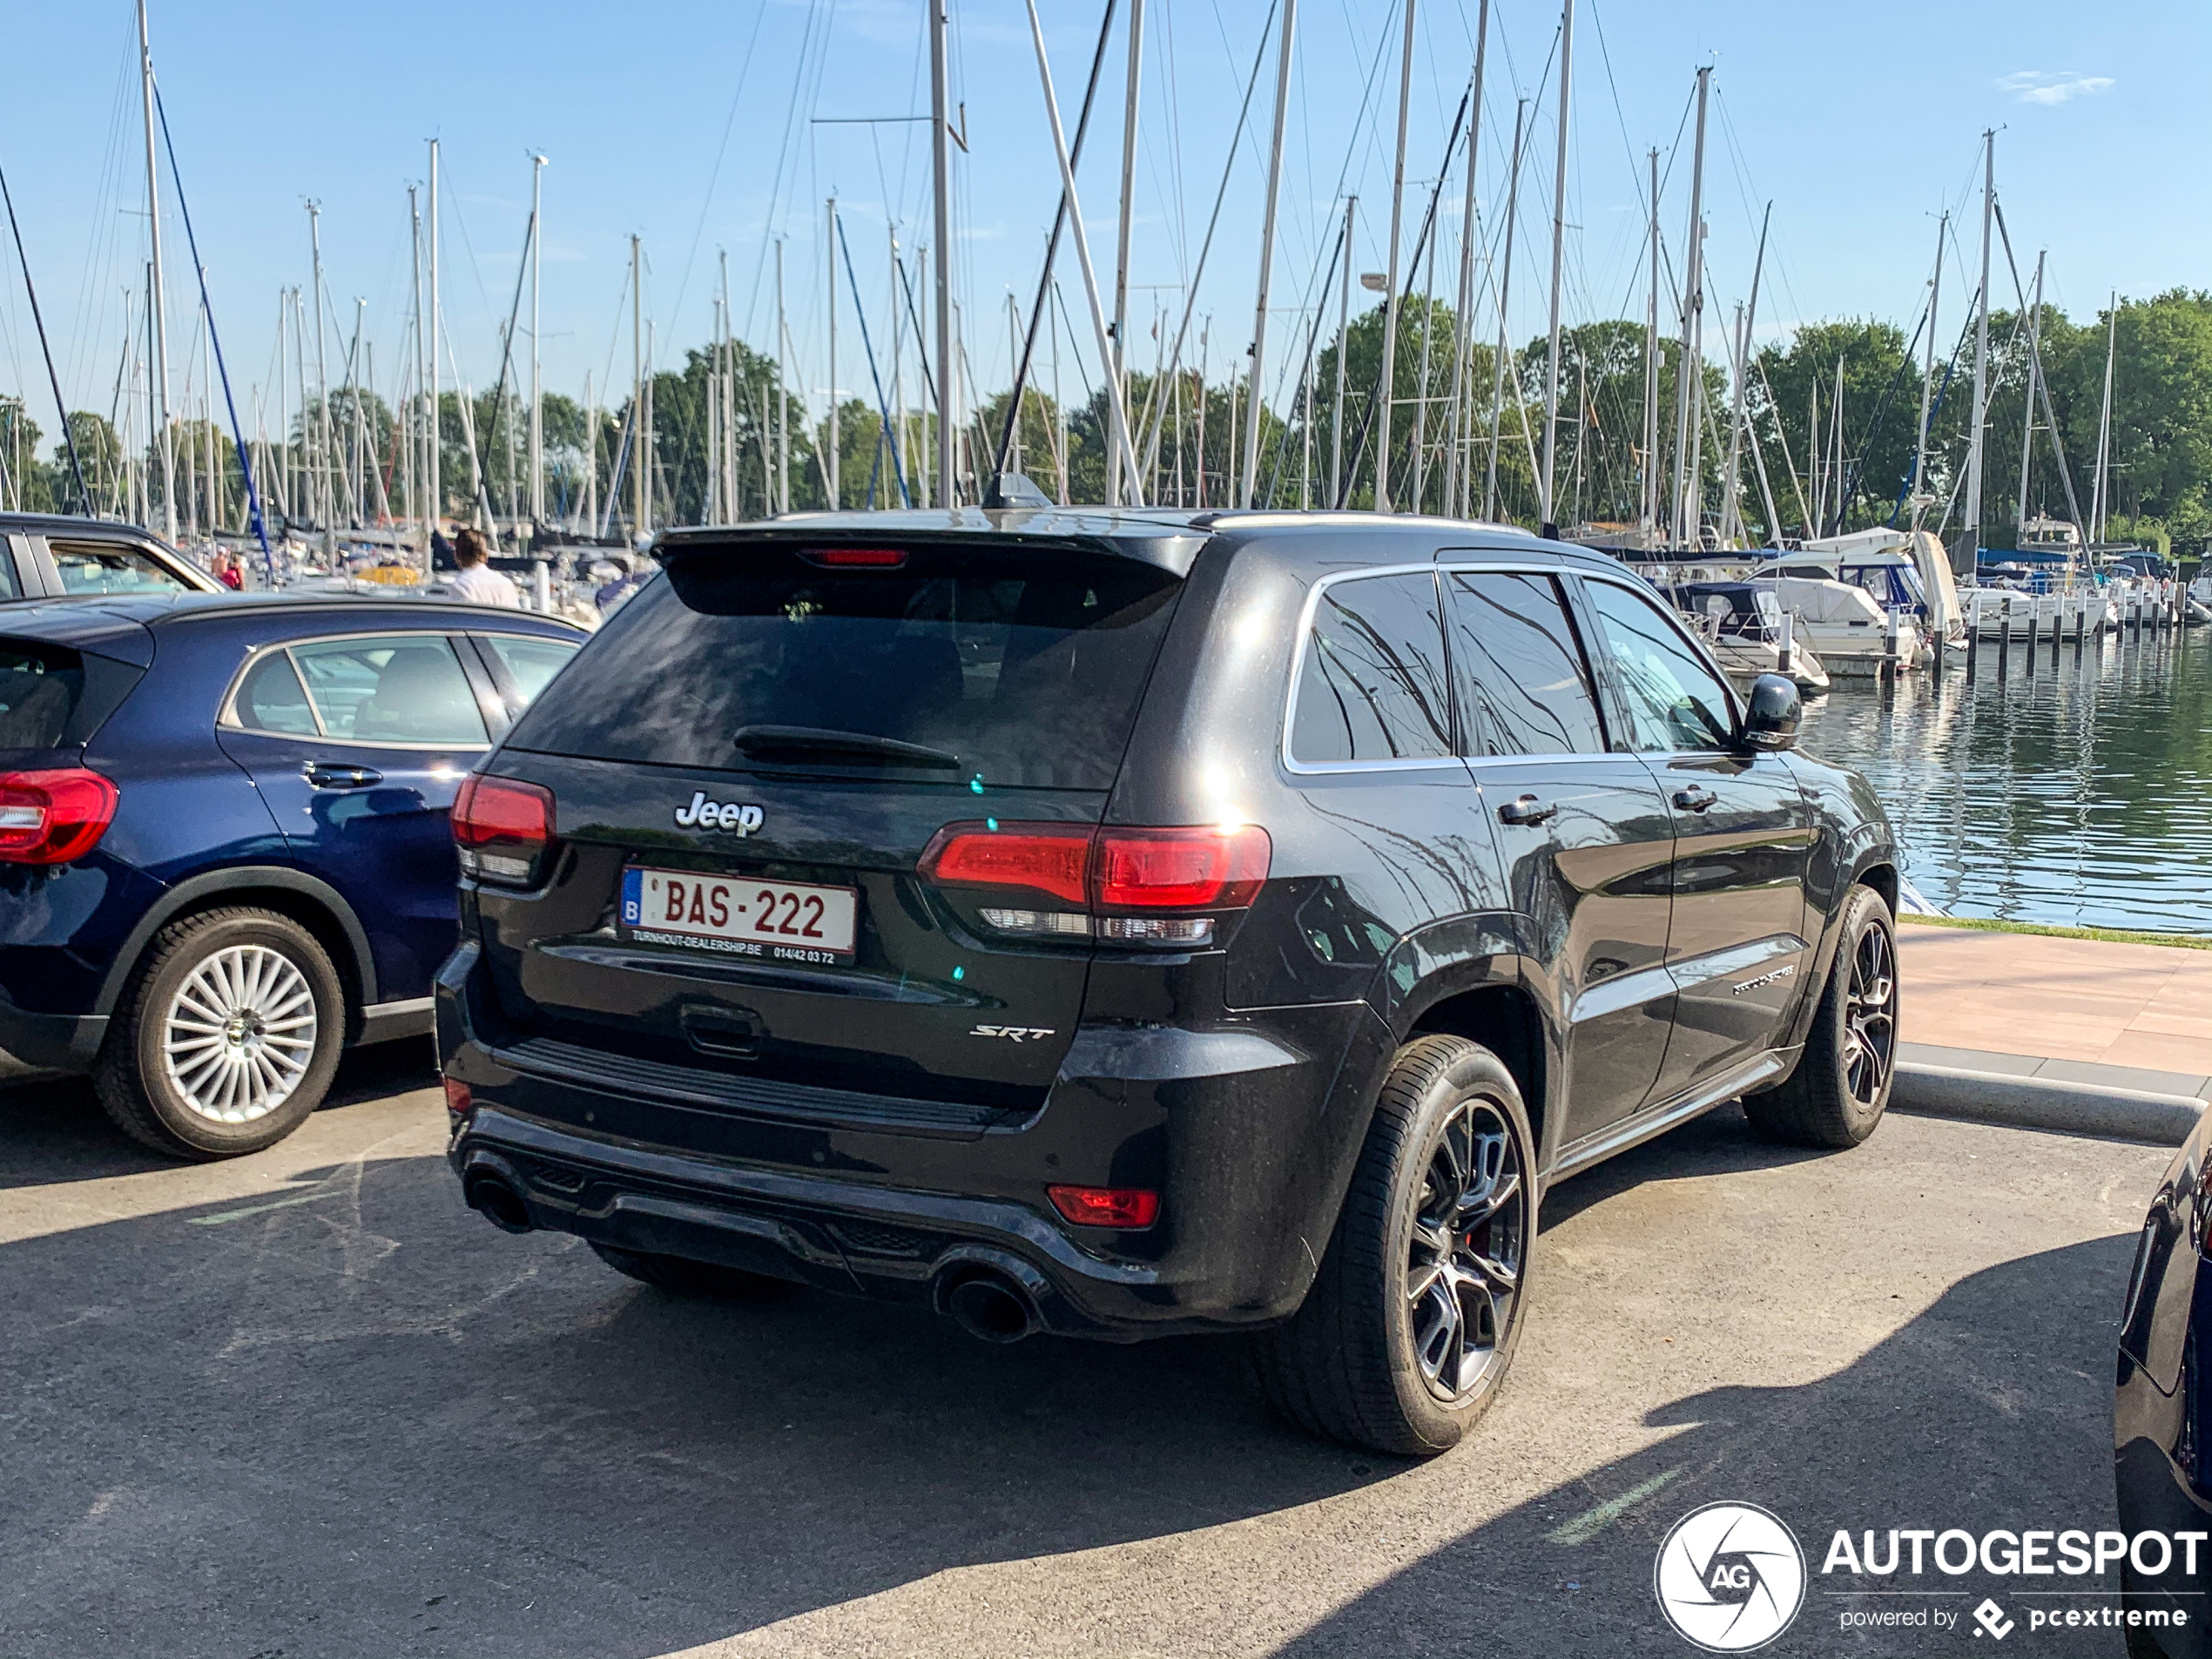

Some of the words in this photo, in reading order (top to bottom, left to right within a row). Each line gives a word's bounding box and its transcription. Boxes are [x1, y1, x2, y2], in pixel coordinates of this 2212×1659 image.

[675, 791, 764, 839] Jeep
[624, 900, 639, 920] B
[664, 880, 825, 938] BAS-222
[631, 929, 762, 956] TURNHOUT-DEALERSHIP.BE
[773, 947, 806, 961] 014/42
[806, 951, 819, 962] 03
[821, 953, 834, 964] 72
[969, 1024, 1055, 1042] SRT
